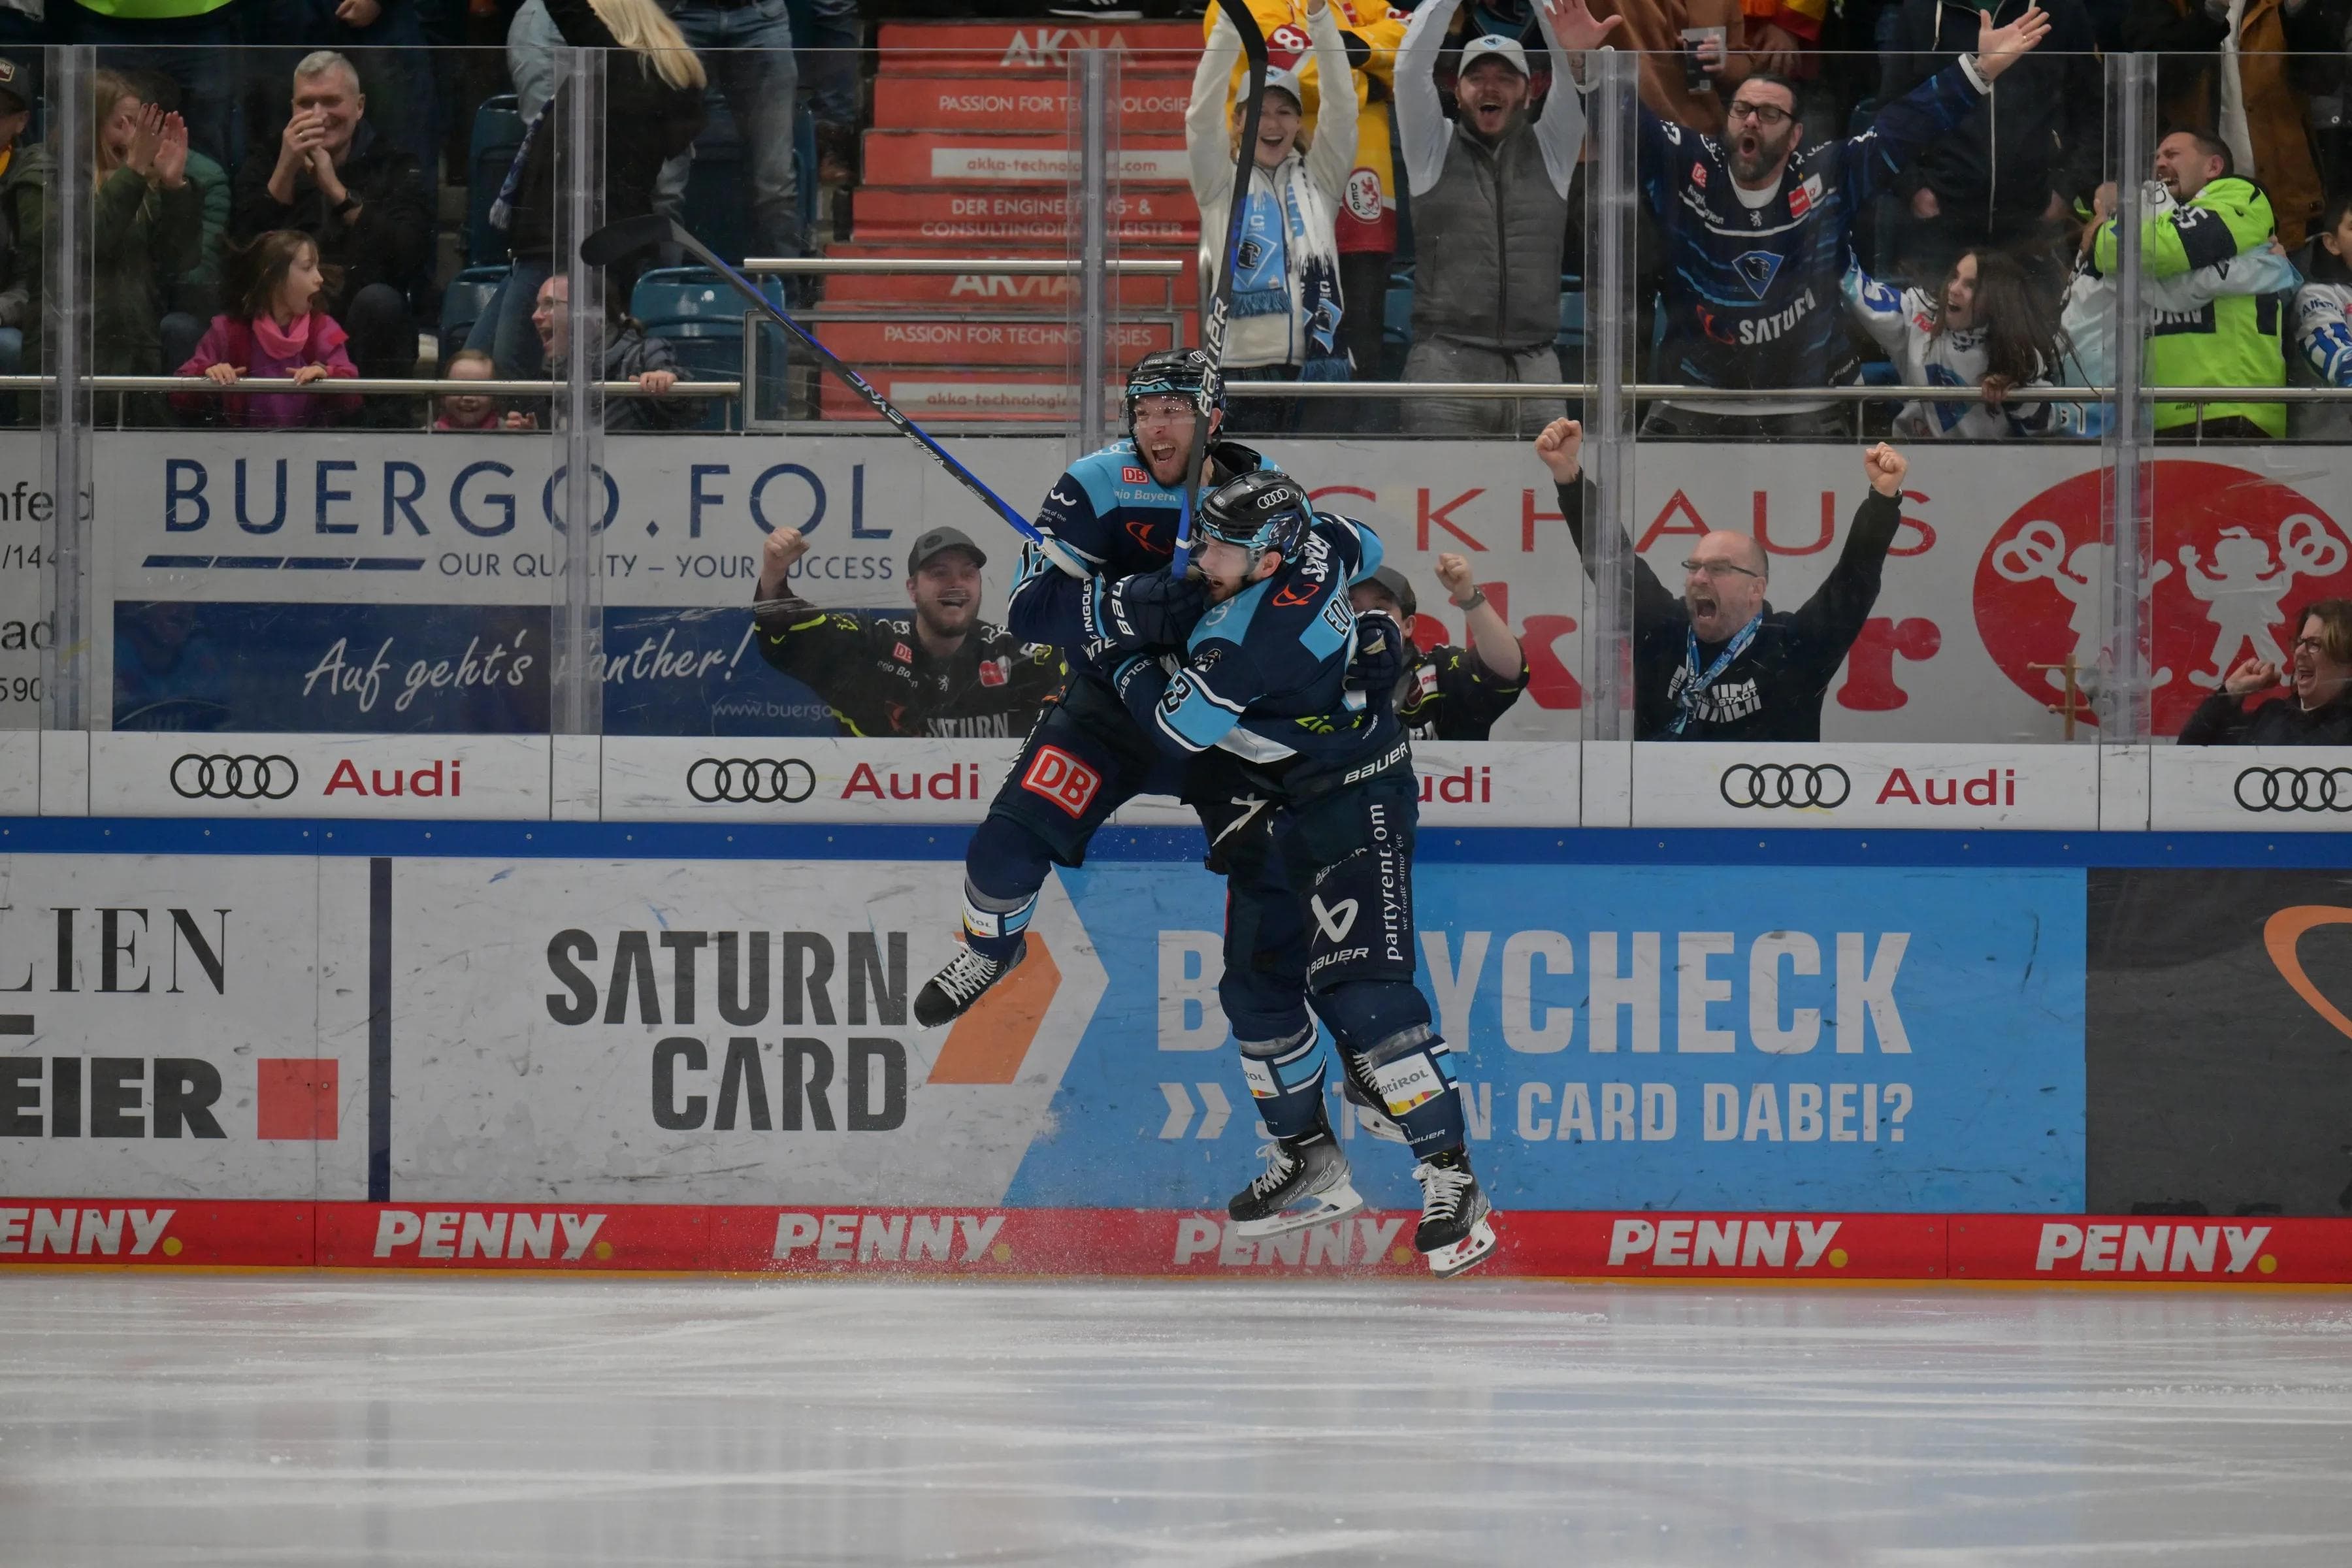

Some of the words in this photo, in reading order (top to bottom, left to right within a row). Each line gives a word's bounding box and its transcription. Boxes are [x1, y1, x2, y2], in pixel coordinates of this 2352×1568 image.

[939, 95, 1013, 112] PASSION
[1019, 96, 1053, 112] FOR
[1058, 96, 1192, 113] TECNOLOGIE
[967, 159, 1157, 174] akka-technolo.com
[952, 199, 988, 216] DER
[994, 199, 1134, 216] ENGINEERG-
[1139, 199, 1152, 215] &
[921, 222, 1183, 237] CONSULTINGDIELEISTER
[884, 325, 961, 342] PASSION
[968, 327, 1002, 344] FOR
[1006, 328, 1152, 346] TECHNOGIES
[1124, 467, 1148, 483] DB
[0, 481, 94, 521] fed
[1134, 489, 1176, 504] Bayern
[438, 553, 500, 577] OUR
[513, 553, 638, 578] QUITY
[676, 555, 755, 578] YOUR
[785, 556, 893, 581] UCCESS
[303, 636, 393, 713] Auf
[394, 629, 533, 712] geht's
[553, 622, 758, 687] anther!
[323, 759, 461, 797] Audi
[840, 762, 979, 801] Audi
[1032, 752, 1092, 807] DB
[1874, 768, 2016, 807] Audi
[1369, 803, 1403, 962] partyrent.om
[546, 928, 909, 1027] SATURN
[1157, 930, 1912, 1054] BYCHECK
[652, 1036, 907, 1132] CARD
[1517, 1081, 1677, 1141] CARD
[1703, 1083, 1914, 1143] DABEI?
